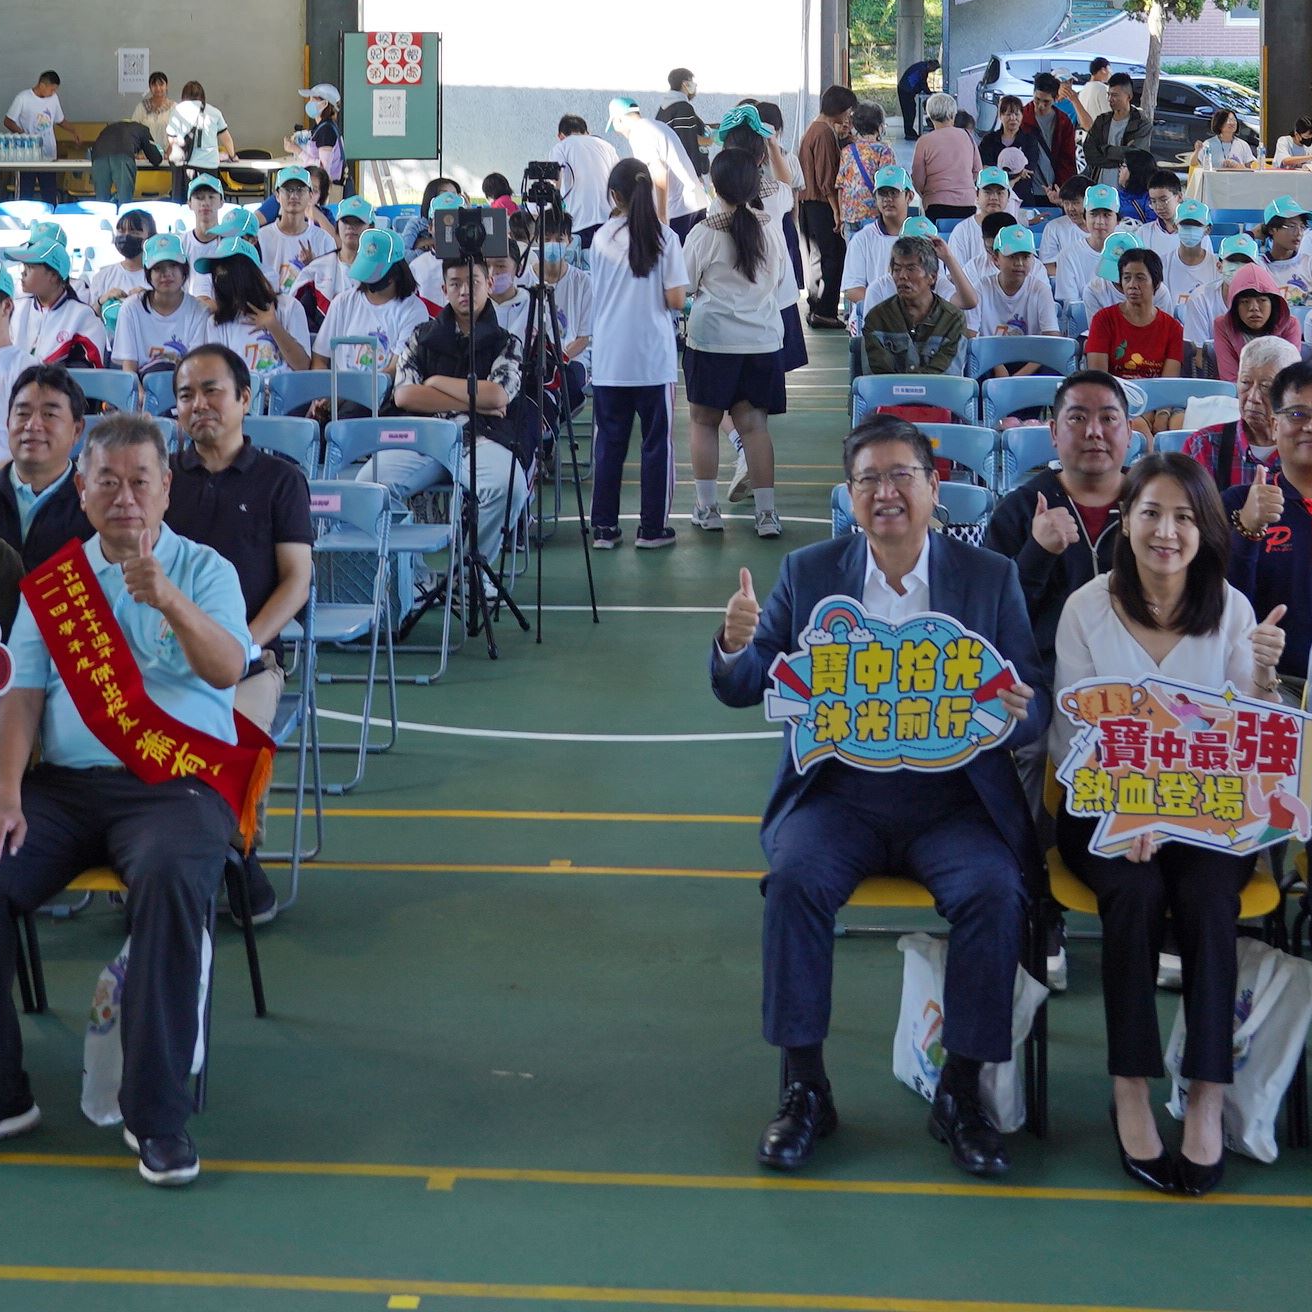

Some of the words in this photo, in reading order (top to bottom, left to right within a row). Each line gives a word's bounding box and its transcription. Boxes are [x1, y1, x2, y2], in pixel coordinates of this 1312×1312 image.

[810, 638, 984, 696] 寶中拾光
[814, 696, 973, 742] 沐光前行
[1099, 711, 1300, 776] 寶中最強
[1073, 767, 1245, 821] 熱血登場
